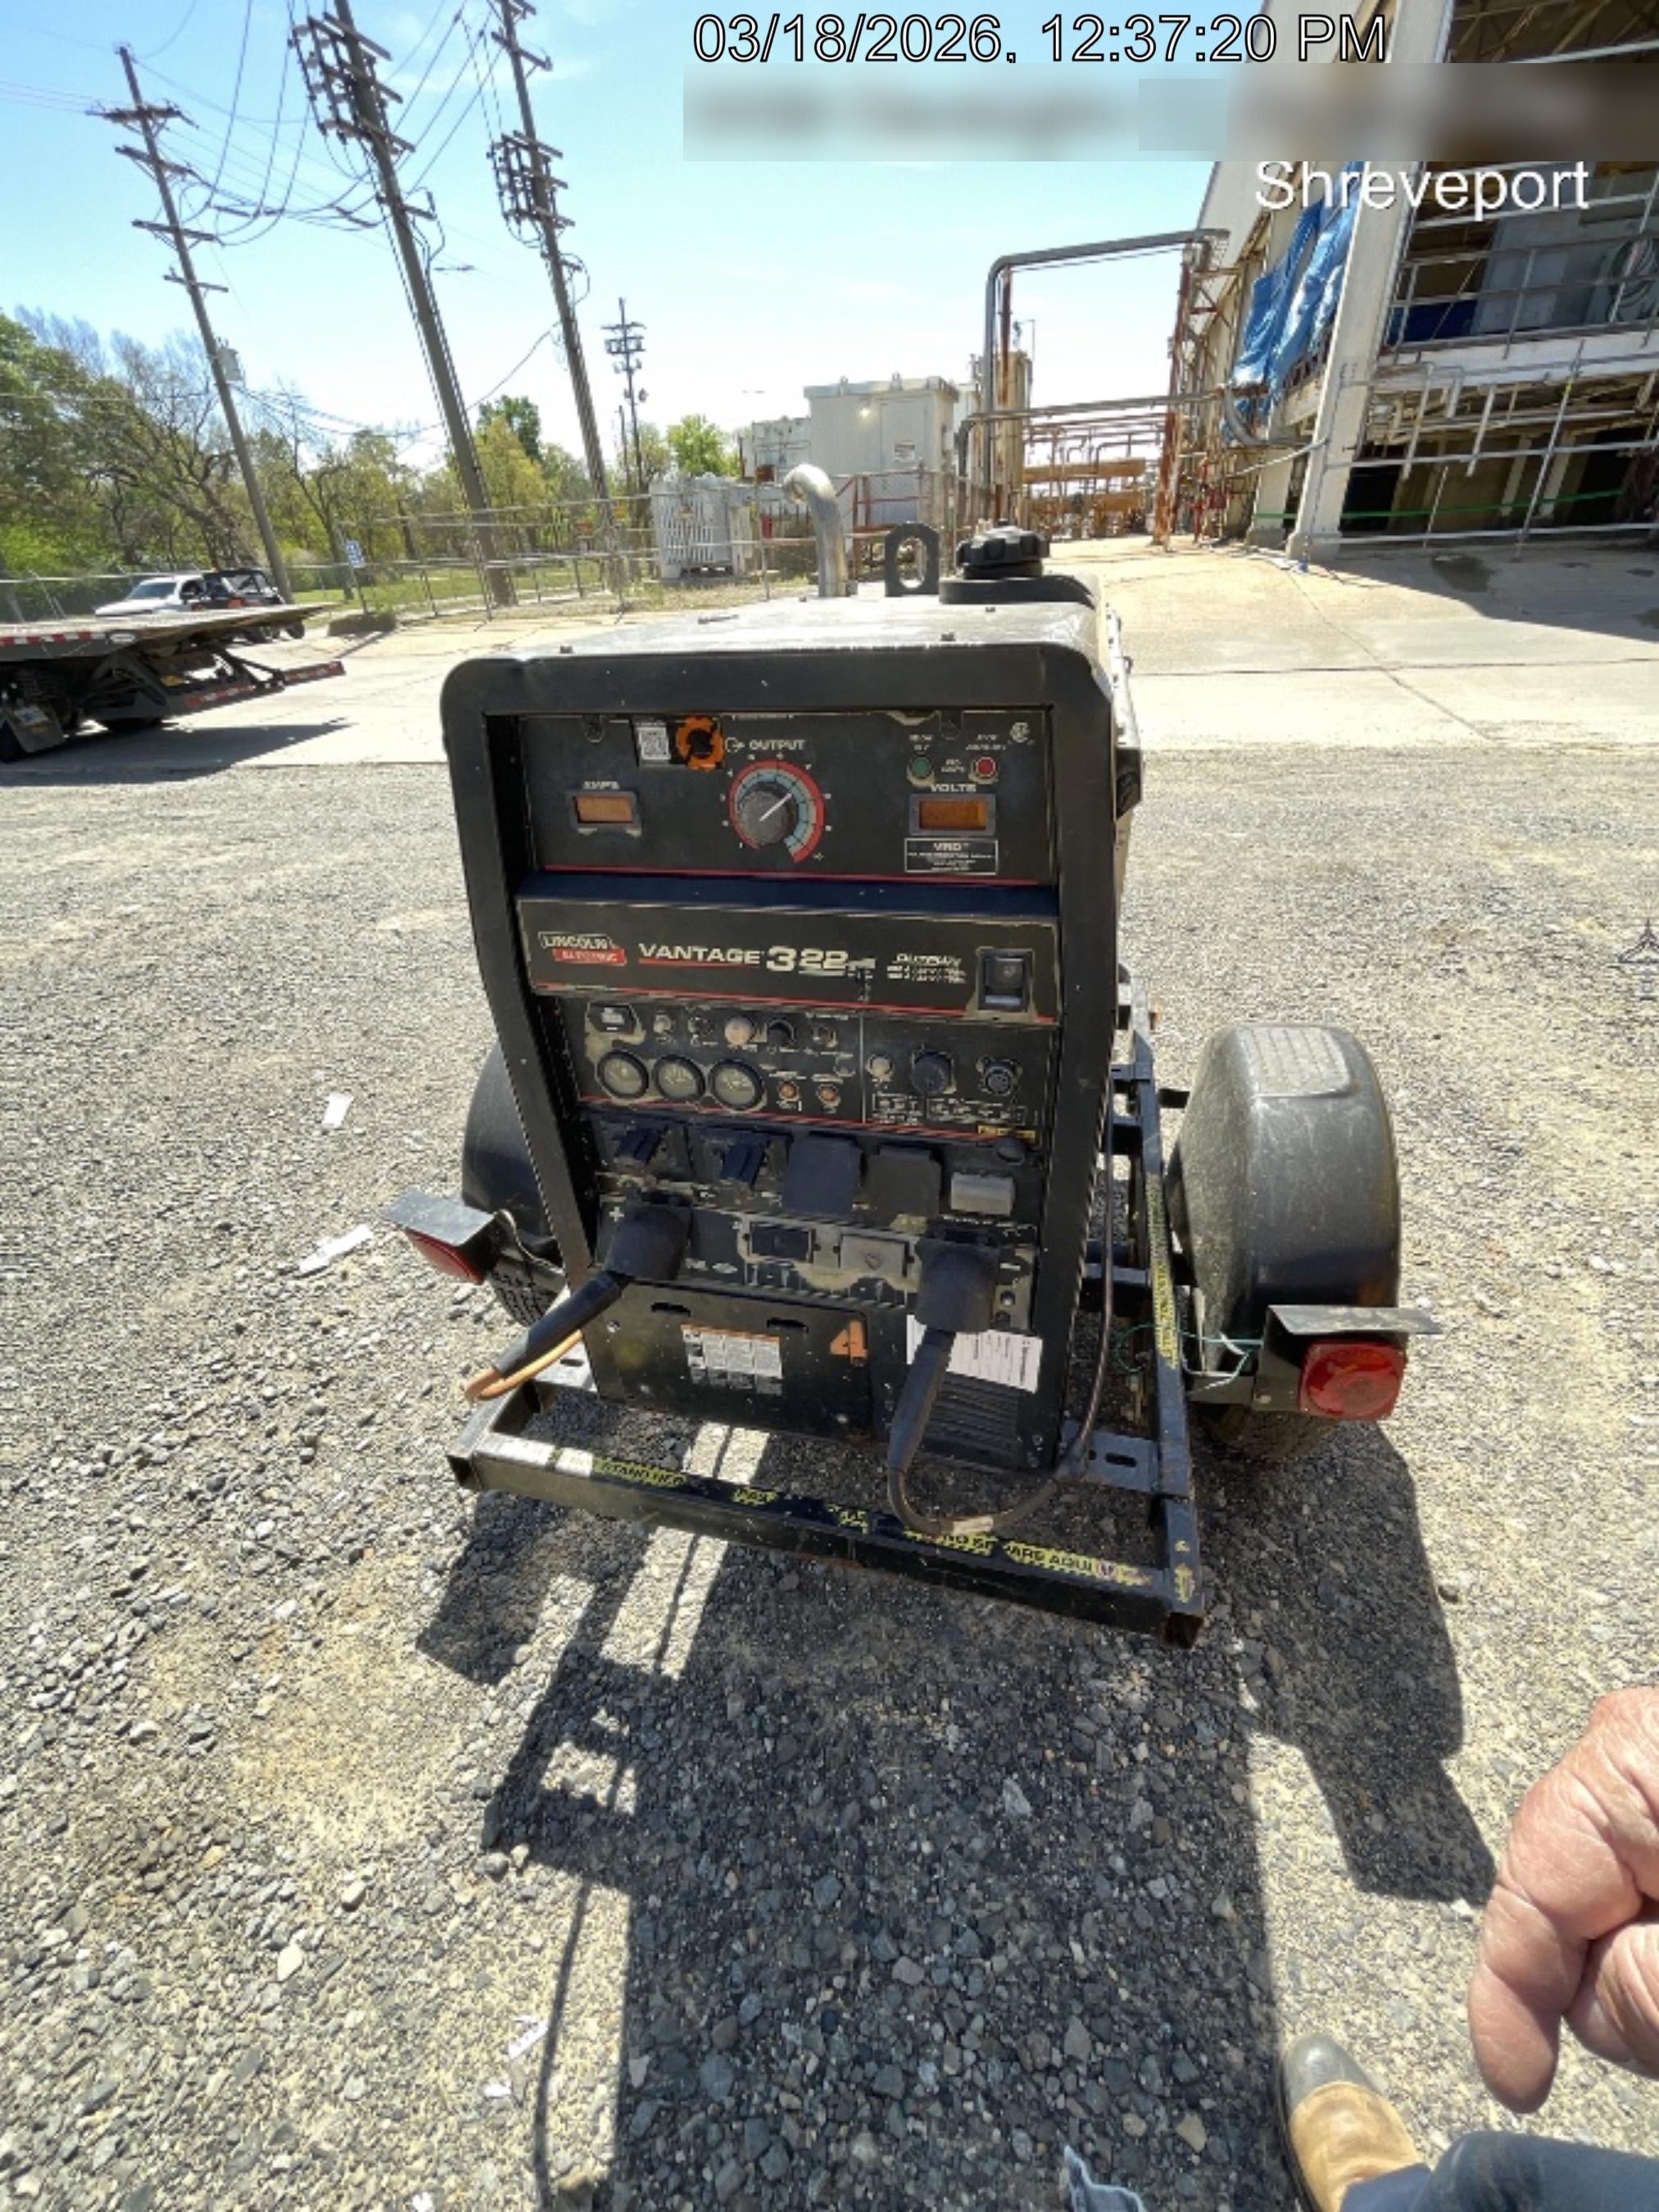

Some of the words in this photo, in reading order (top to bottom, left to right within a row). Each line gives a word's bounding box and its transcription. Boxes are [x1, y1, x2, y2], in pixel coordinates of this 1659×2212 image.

[748, 739, 806, 750] OUTPUT
[931, 783, 977, 793] VOLTS
[542, 935, 608, 950] LINCOLN
[638, 943, 761, 965] VANTAGE
[766, 945, 849, 972] 322
[829, 1320, 868, 1362] 4
